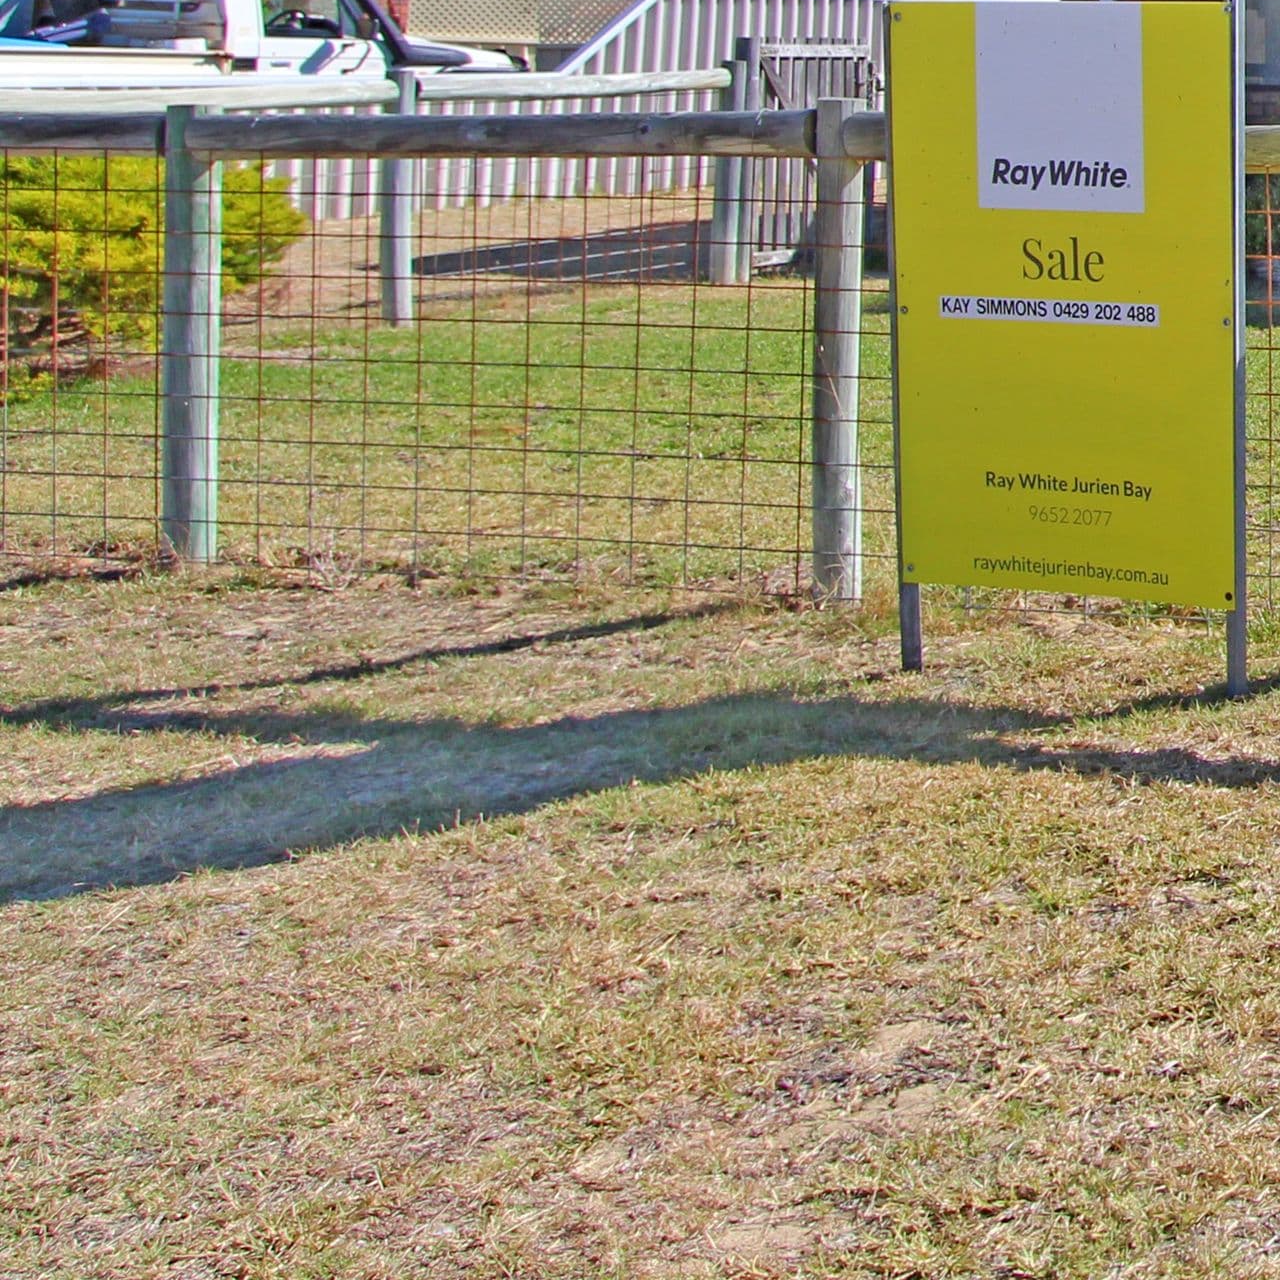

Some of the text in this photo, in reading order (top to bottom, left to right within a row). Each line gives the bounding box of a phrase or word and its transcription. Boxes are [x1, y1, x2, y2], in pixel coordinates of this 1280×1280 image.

[1022, 236, 1105, 282] Sale
[941, 297, 1156, 323] KAY SIMMONS 0429 202 488
[985, 471, 1152, 502] Ray White Jurien Bay
[1028, 505, 1113, 527] 9652 2077
[973, 555, 1169, 586] raywhitejurienbay.com.au
